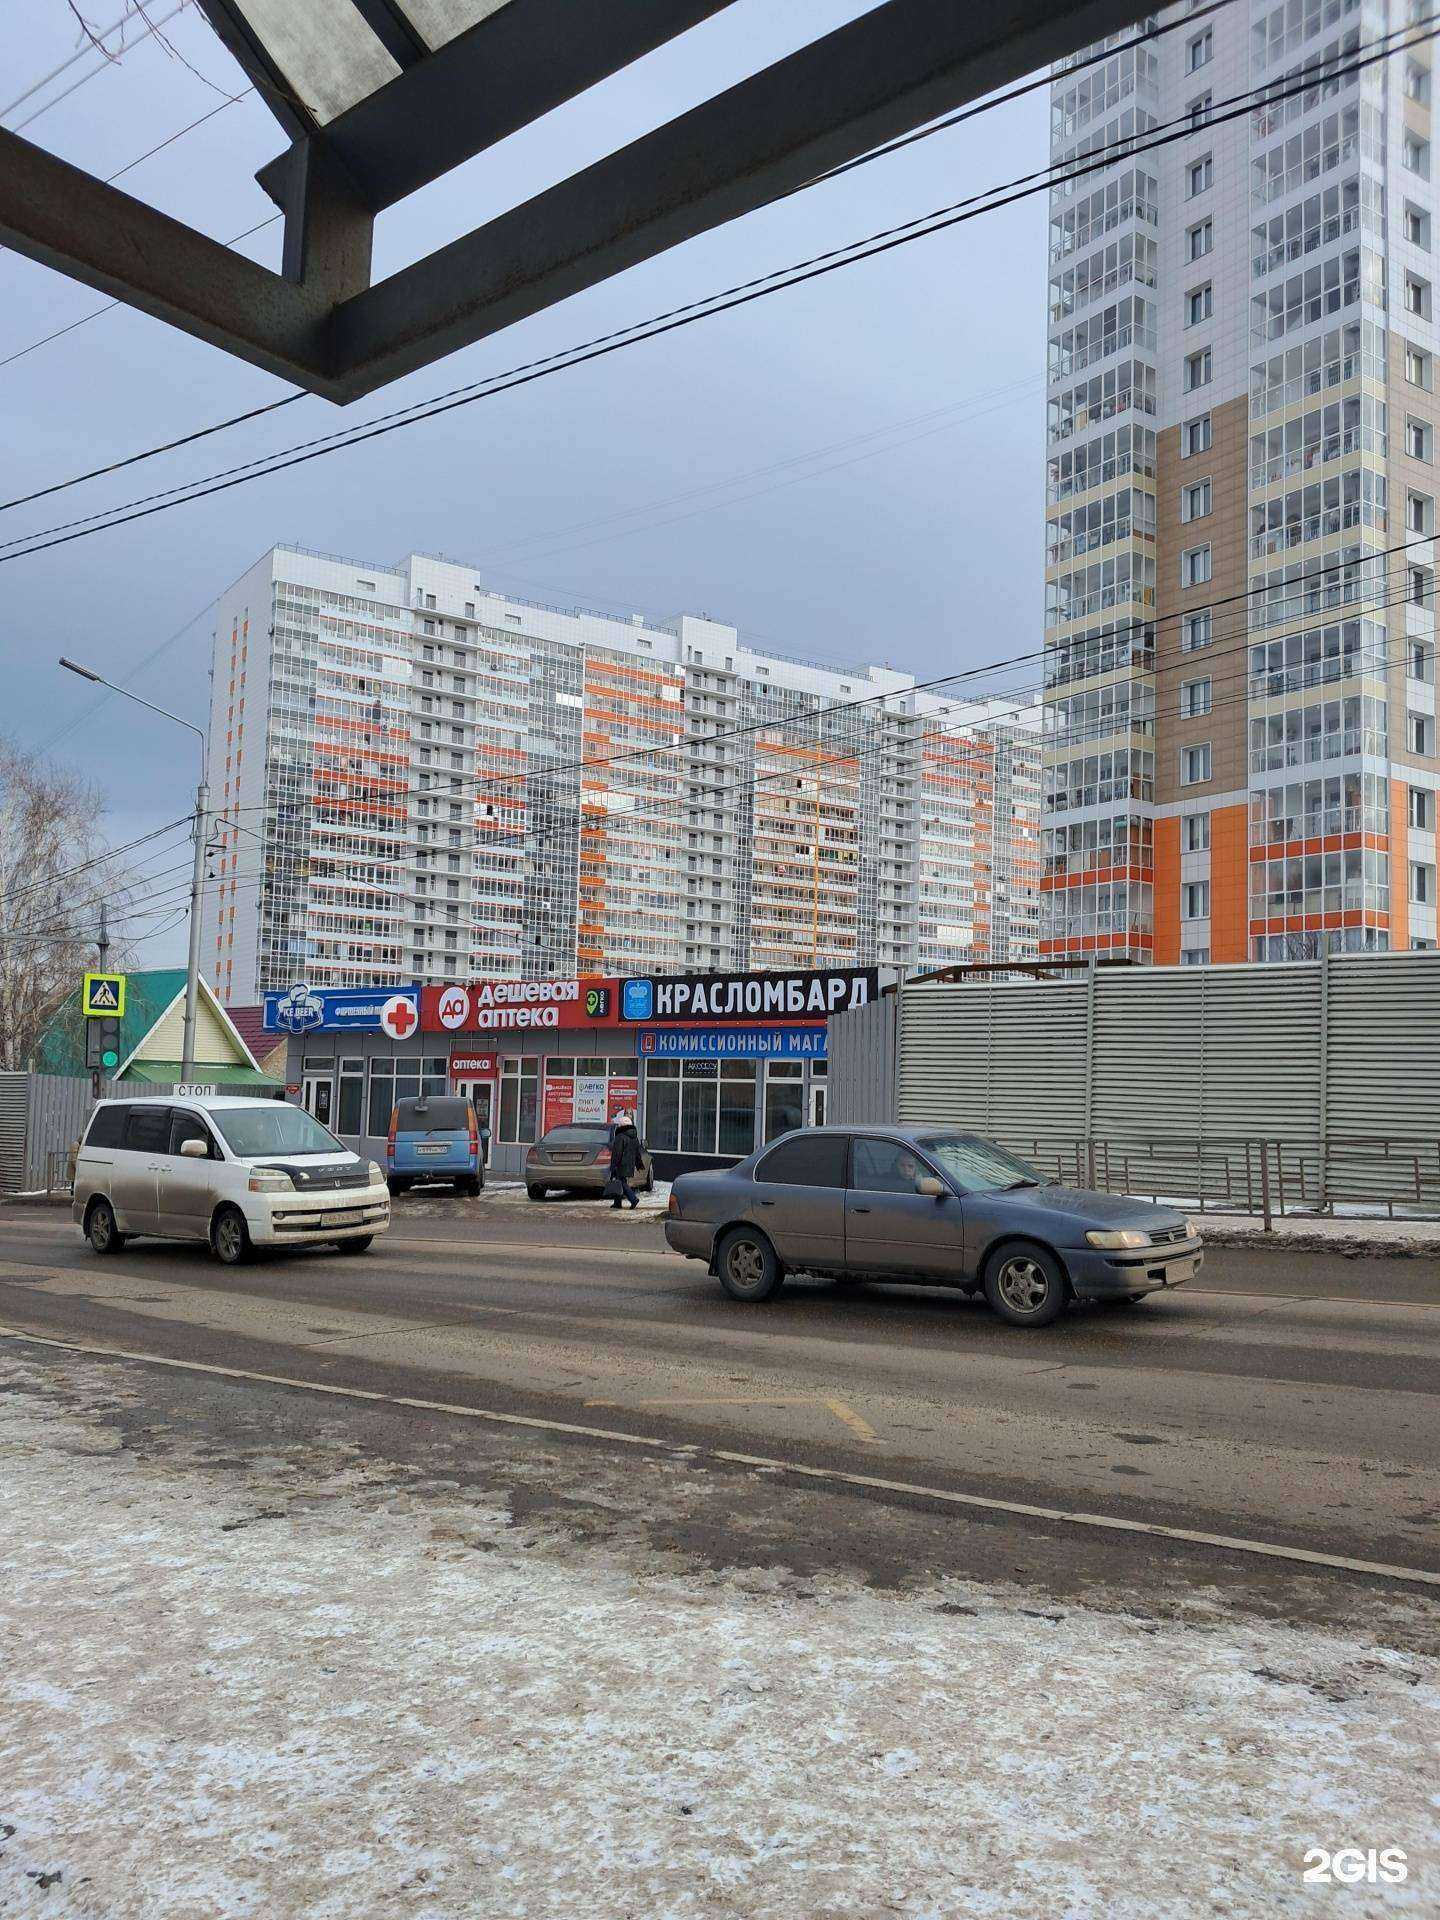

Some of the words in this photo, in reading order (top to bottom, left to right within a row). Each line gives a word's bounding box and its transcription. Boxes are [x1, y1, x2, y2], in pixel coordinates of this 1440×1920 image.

[657, 977, 868, 1014] КРАСЛОМБАРД
[283, 1007, 294, 1017] ICE
[295, 1007, 314, 1017] BEER
[659, 1031, 782, 1052] КОМИССИОННЫЙ
[178, 1085, 211, 1097] СТОП
